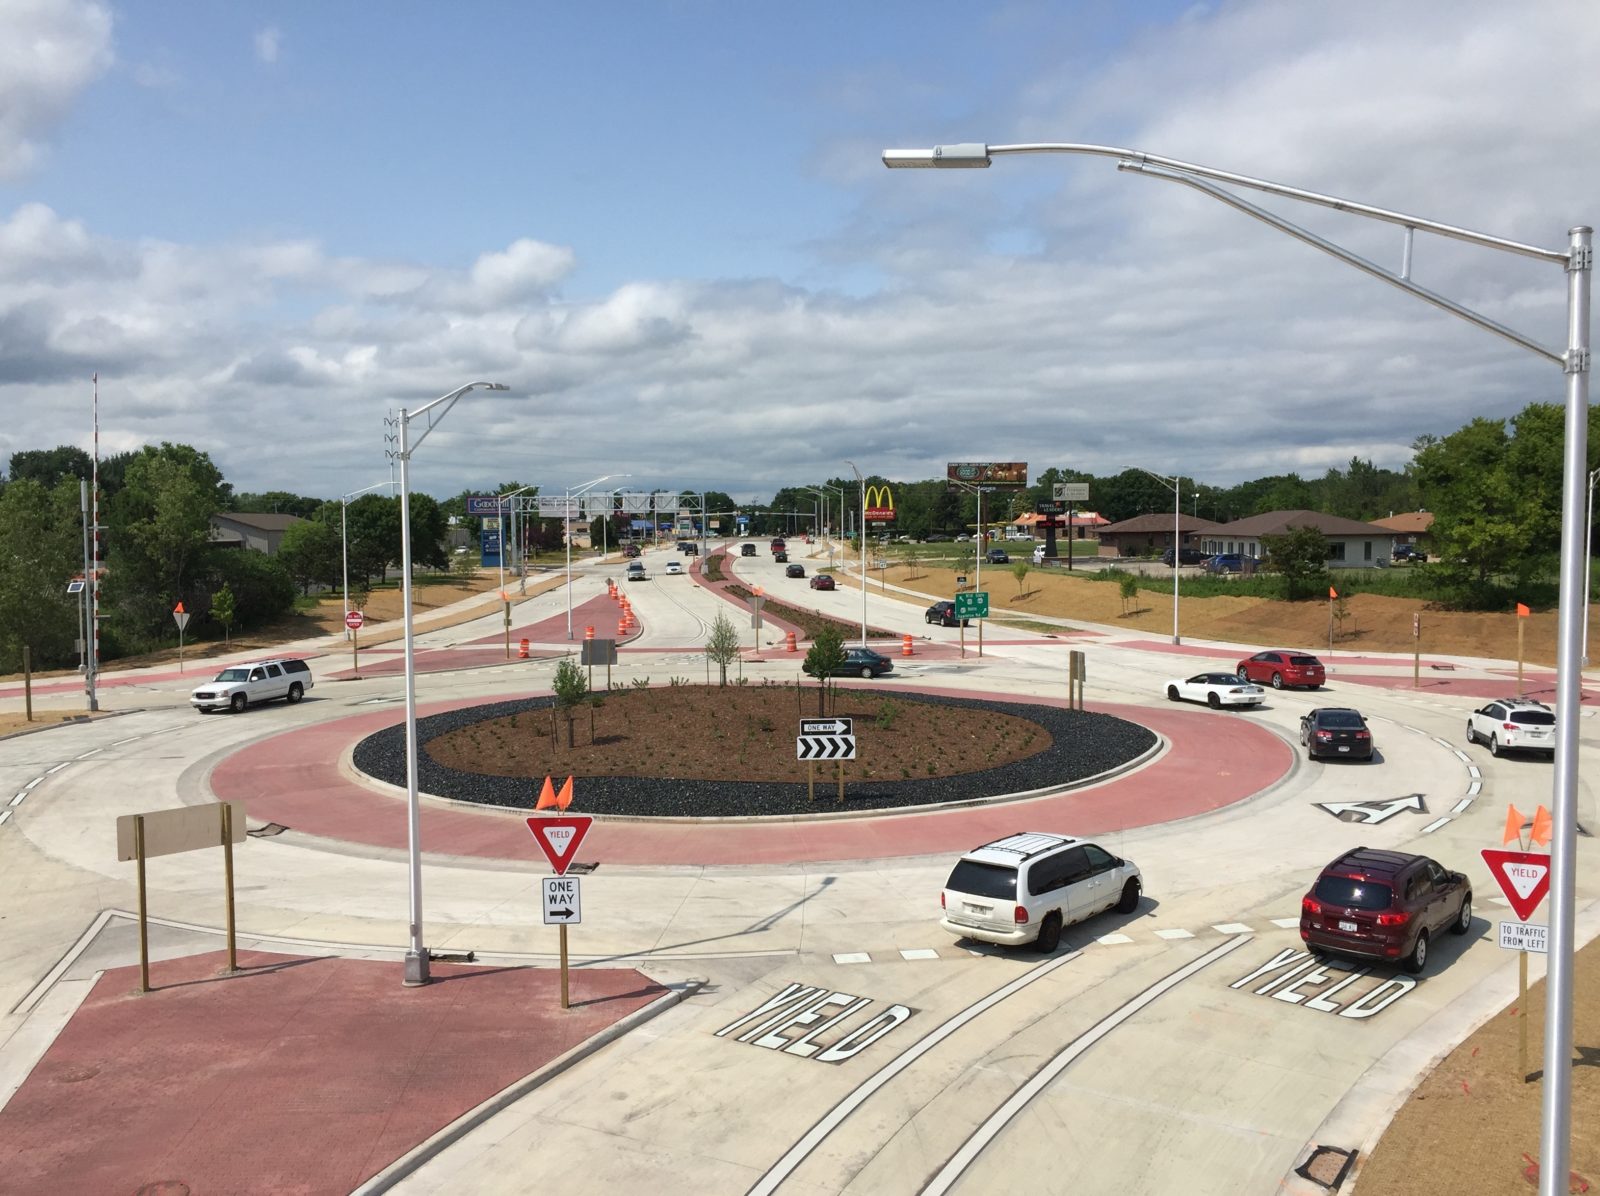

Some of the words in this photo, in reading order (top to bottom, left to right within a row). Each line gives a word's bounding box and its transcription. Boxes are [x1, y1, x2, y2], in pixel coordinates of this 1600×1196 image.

[550, 830, 570, 839] YIELD
[1511, 868, 1538, 878] YIELD
[549, 881, 573, 892] ONE
[548, 893, 575, 905] WAY
[1503, 925, 1512, 934] TO
[1516, 926, 1546, 938] TRAFFIC
[1503, 936, 1523, 946] FROM
[1527, 939, 1545, 949] LEFT
[1229, 947, 1417, 1018] YIELD
[713, 982, 913, 1062] YIELD
